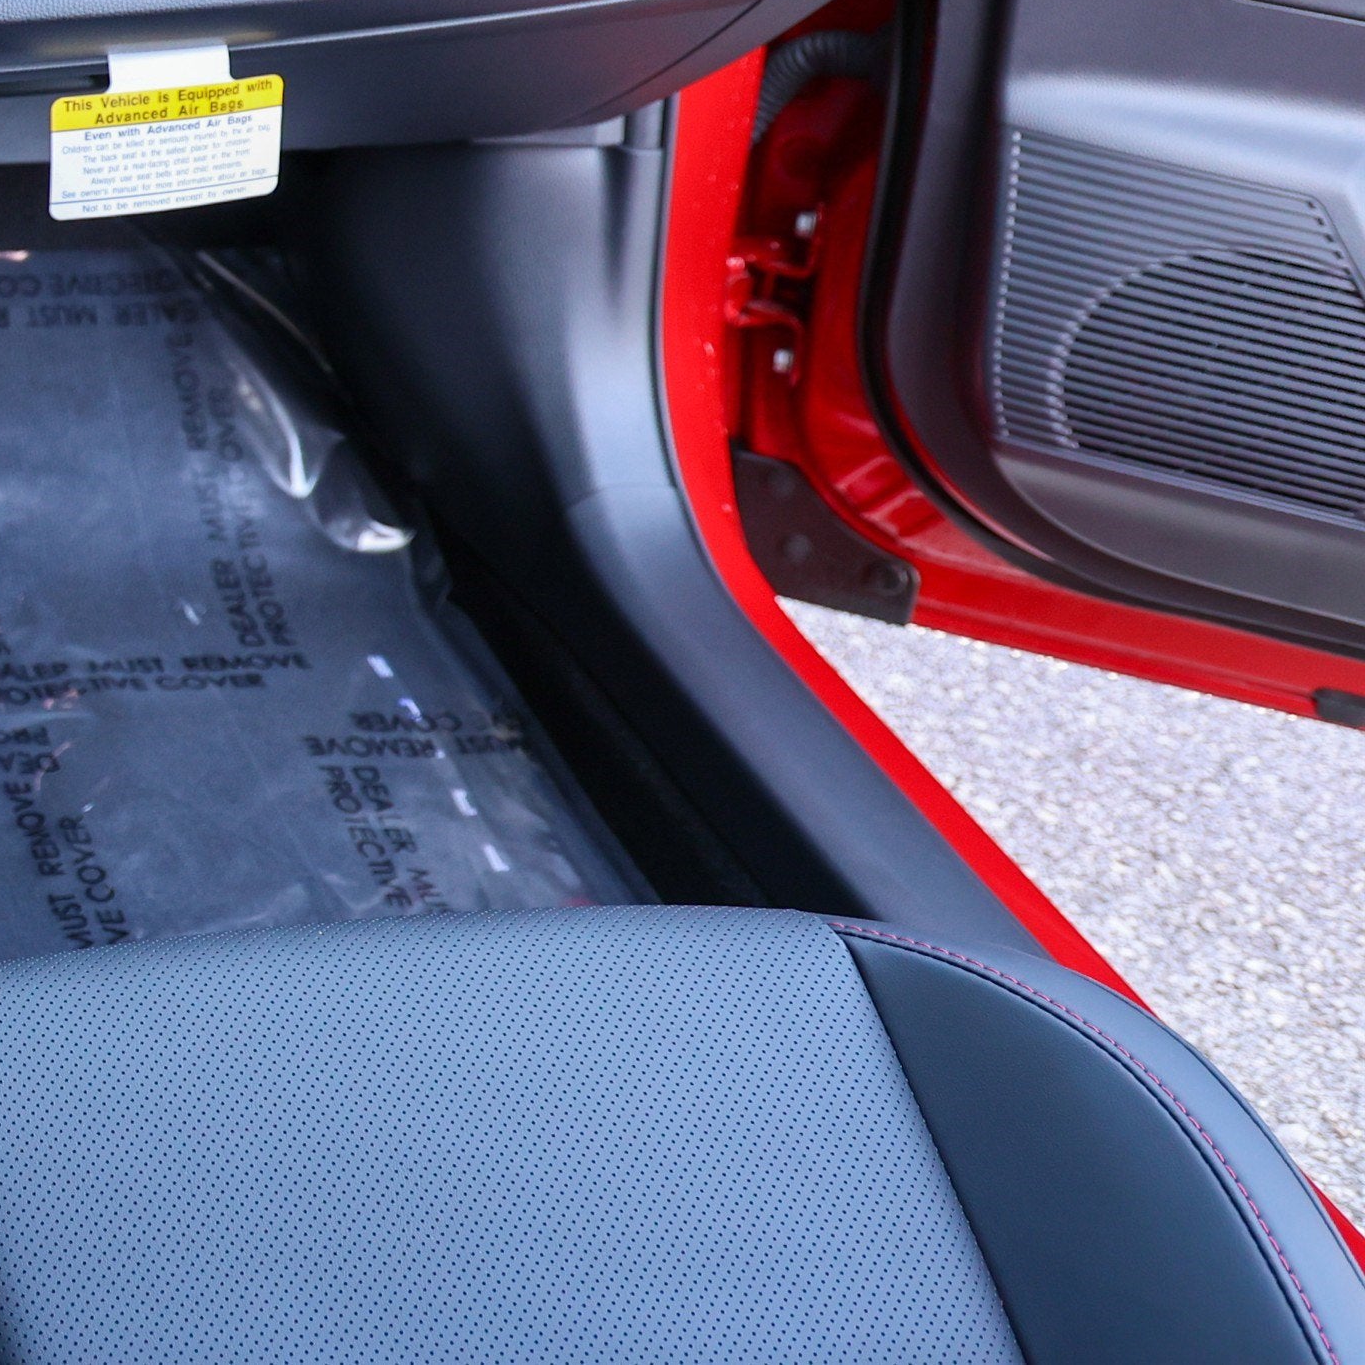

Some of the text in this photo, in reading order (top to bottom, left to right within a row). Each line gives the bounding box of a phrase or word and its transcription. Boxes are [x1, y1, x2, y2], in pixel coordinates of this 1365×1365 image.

[63, 78, 273, 113] This Vehicle is Equipped with
[83, 114, 253, 141] Even with Advanced Air Bags
[94, 98, 245, 124] Advanced Air Bags
[3, 779, 67, 878] REMOVE
[318, 764, 414, 908] PROTECTIVE
[351, 764, 418, 854] DEALER
[57, 813, 117, 904] COVER
